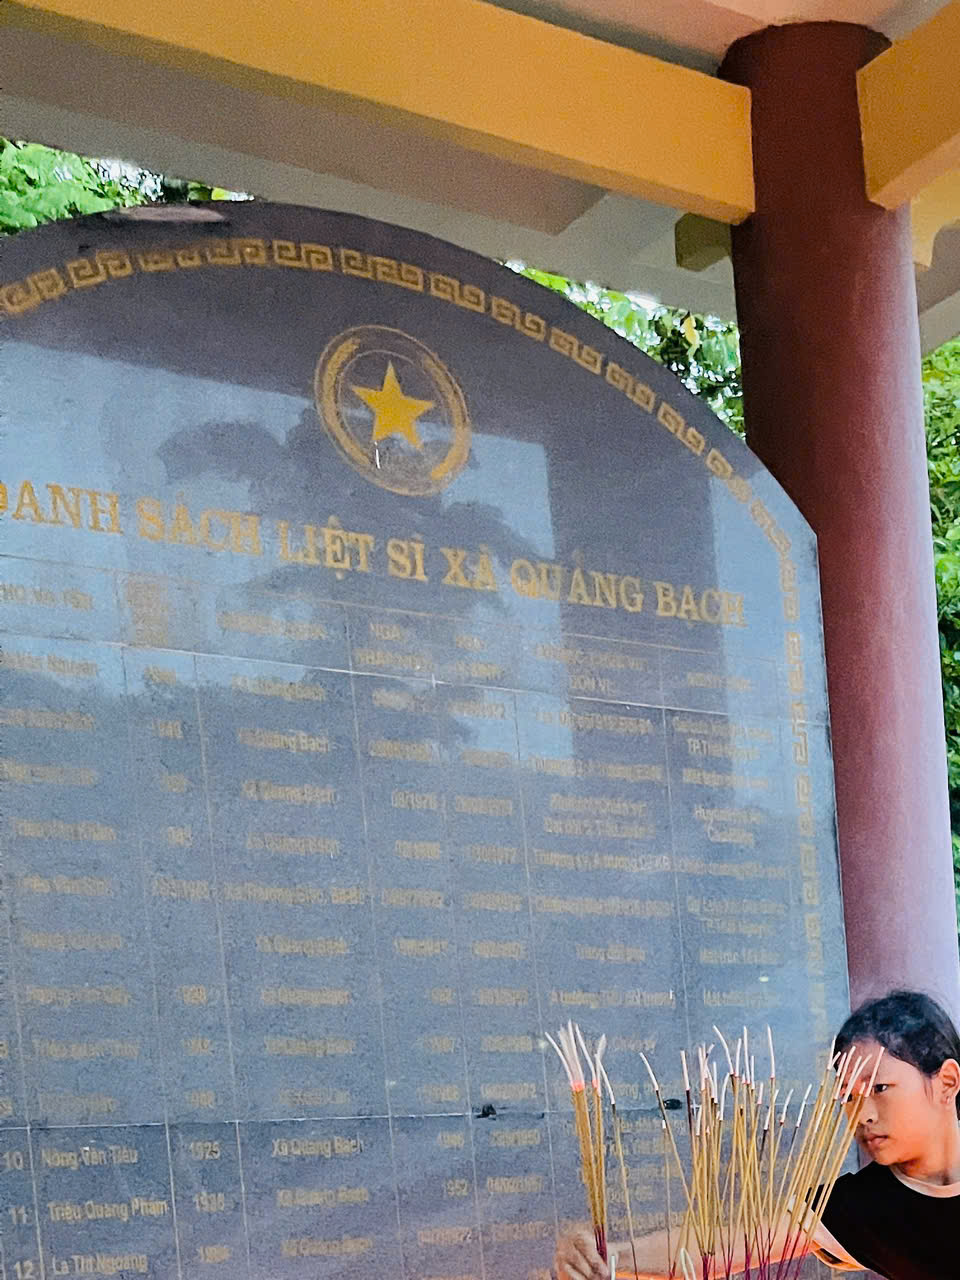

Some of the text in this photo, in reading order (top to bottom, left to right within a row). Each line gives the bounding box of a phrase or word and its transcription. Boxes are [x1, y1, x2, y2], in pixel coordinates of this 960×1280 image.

[0, 479, 124, 536] ANH
[276, 514, 376, 580] LIỆT
[653, 579, 748, 630] BẠCH
